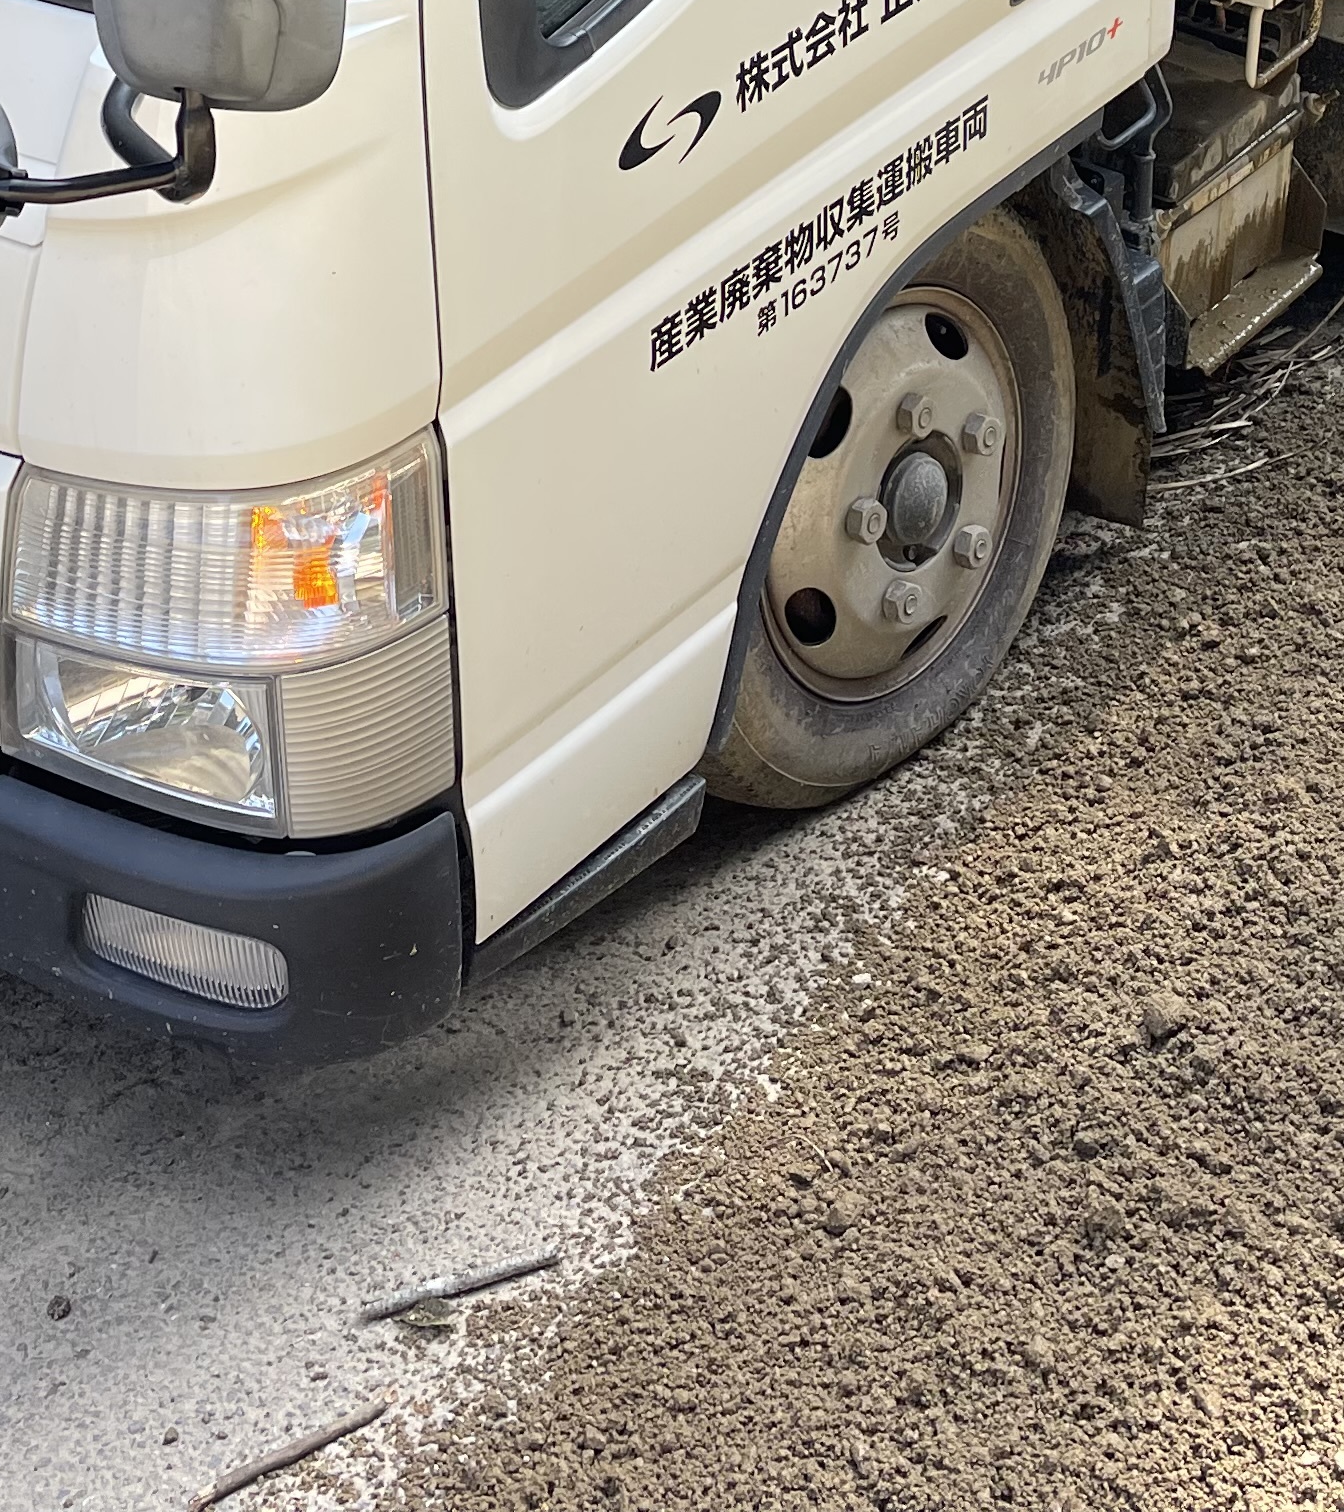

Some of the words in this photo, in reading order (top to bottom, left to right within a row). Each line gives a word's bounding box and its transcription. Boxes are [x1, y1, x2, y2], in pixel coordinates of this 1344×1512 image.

[650, 94, 990, 372] 産業廃棄物収集運搬車両
[757, 210, 901, 337] 第163737号
